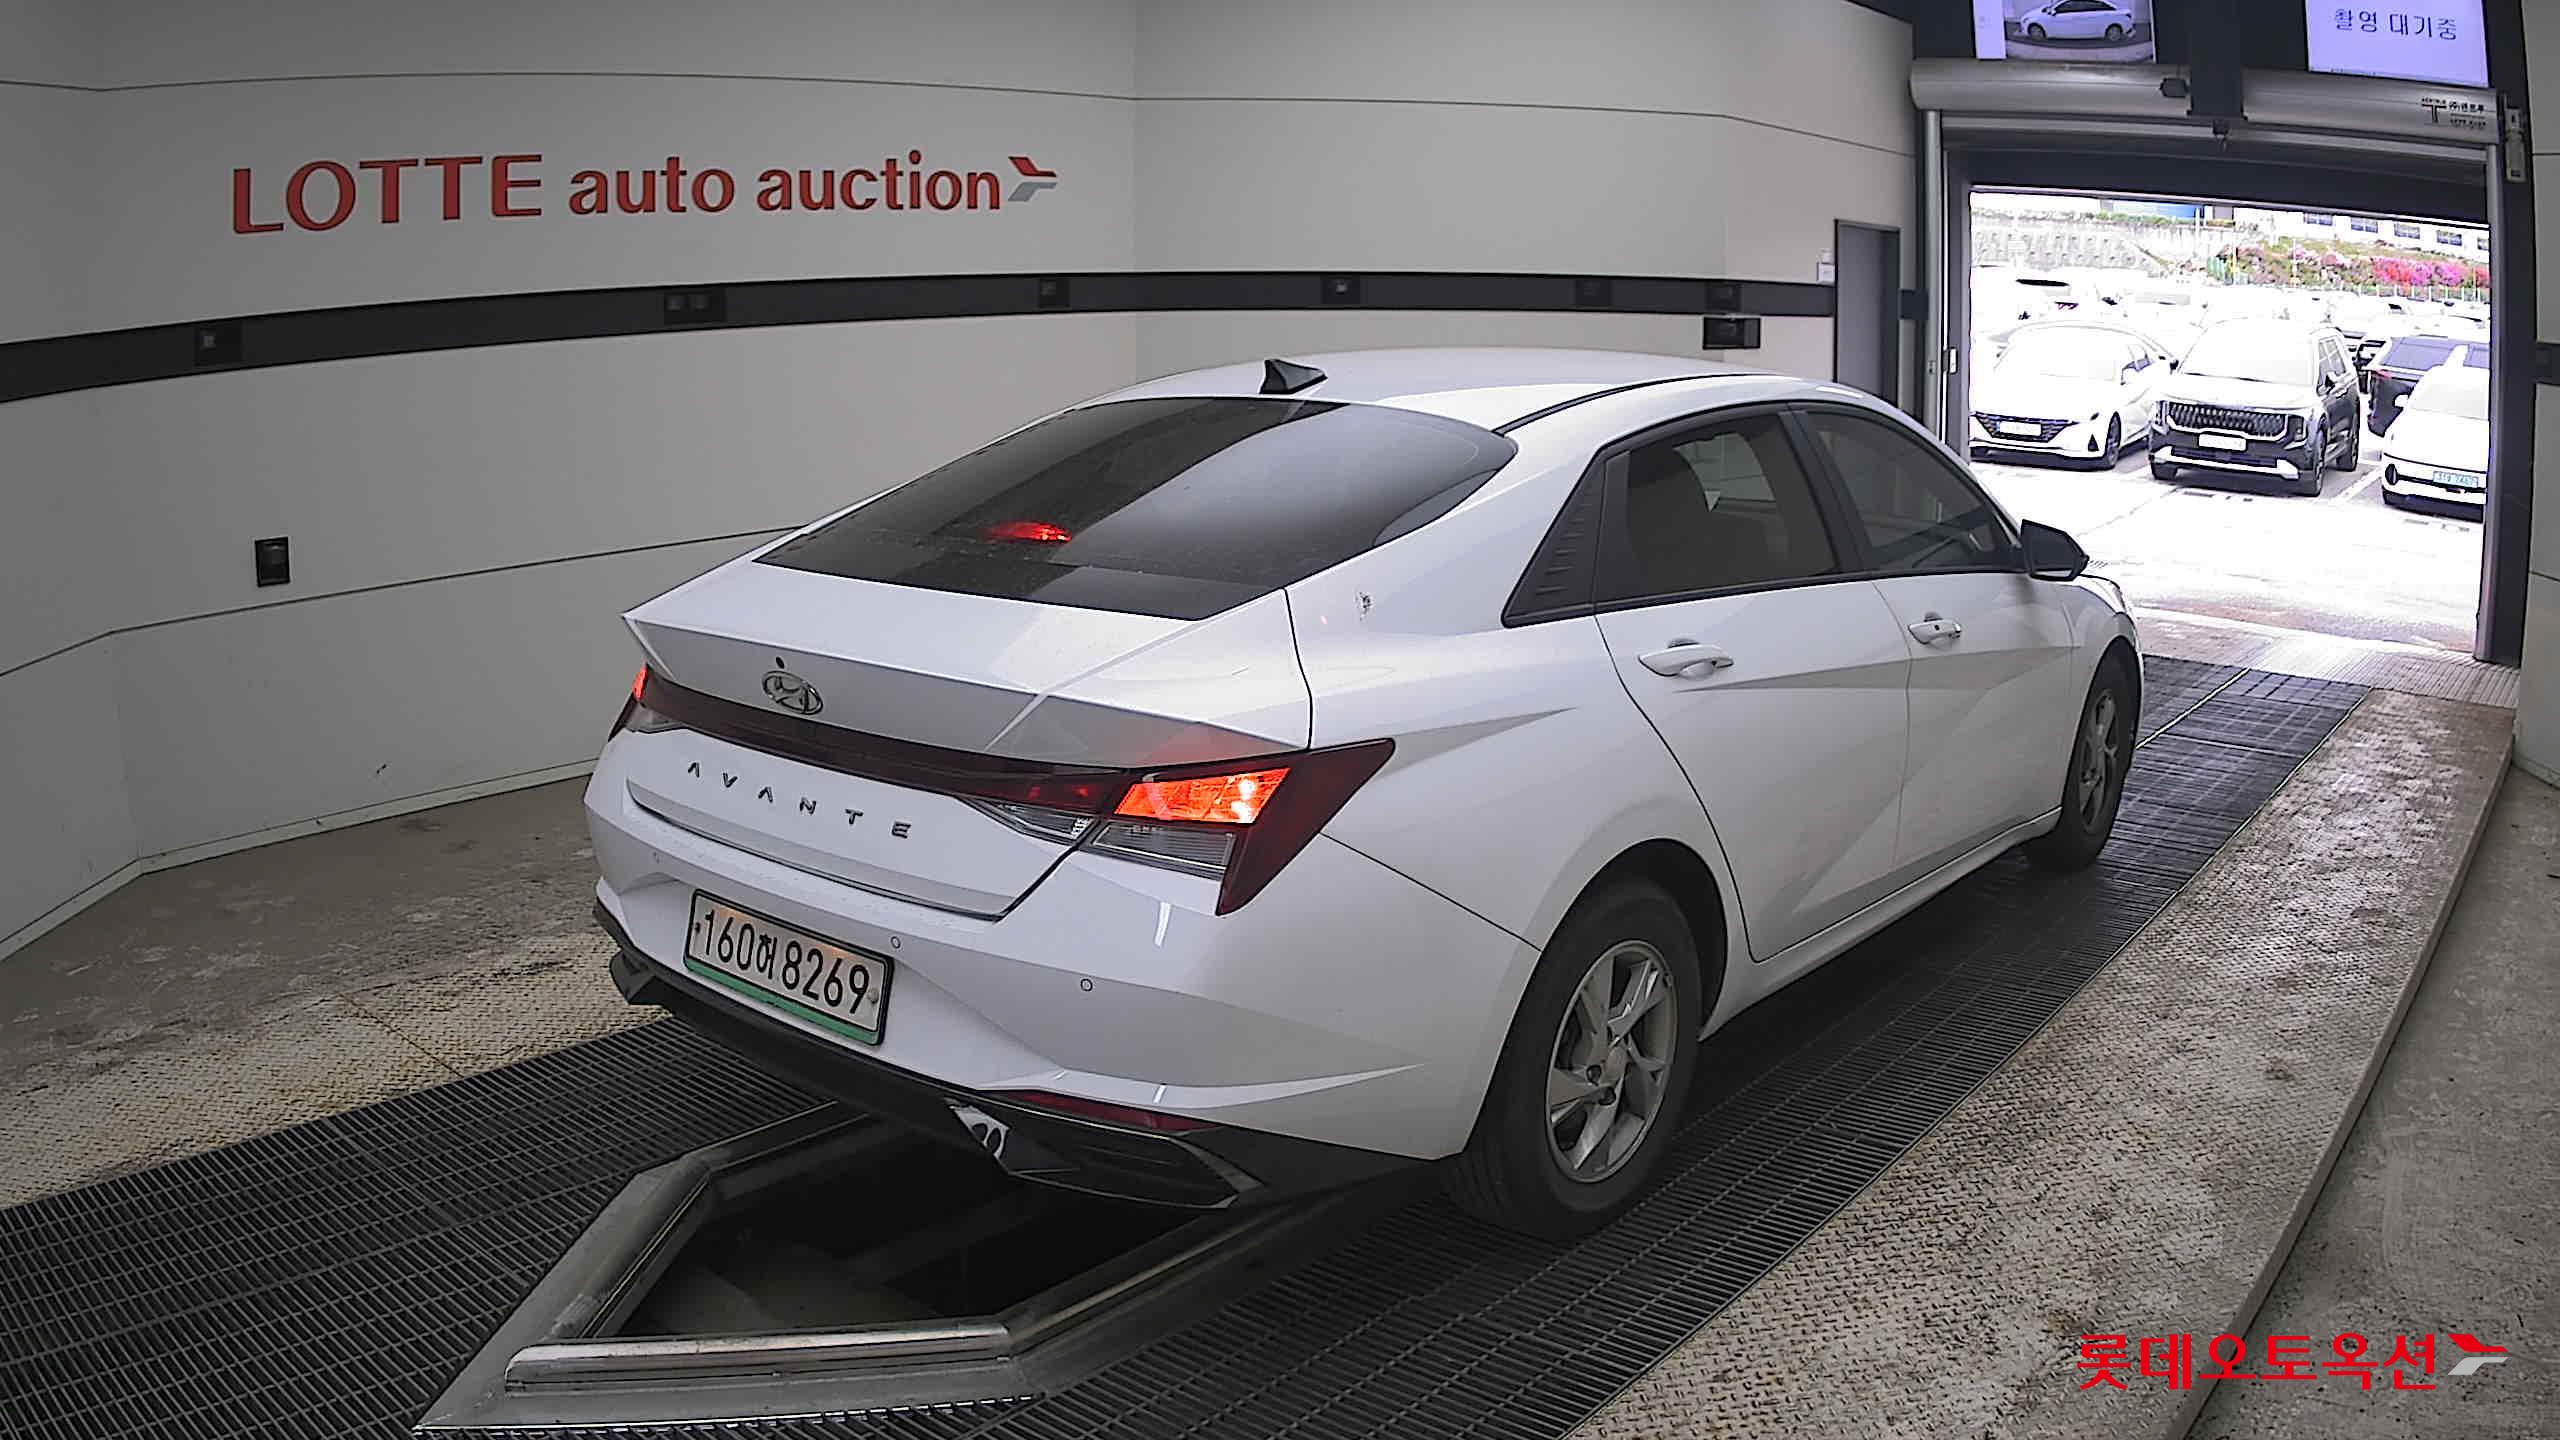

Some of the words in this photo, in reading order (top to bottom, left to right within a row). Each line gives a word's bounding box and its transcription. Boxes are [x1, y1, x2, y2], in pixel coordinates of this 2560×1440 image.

[2334, 8, 2378, 33] 촬영
[2389, 13, 2457, 41] 대기중
[233, 154, 543, 234] LOTTE
[569, 156, 737, 214] auto
[755, 151, 1003, 210] auction
[686, 761, 912, 839] AVANTE
[704, 909, 870, 1014] 160허8269
